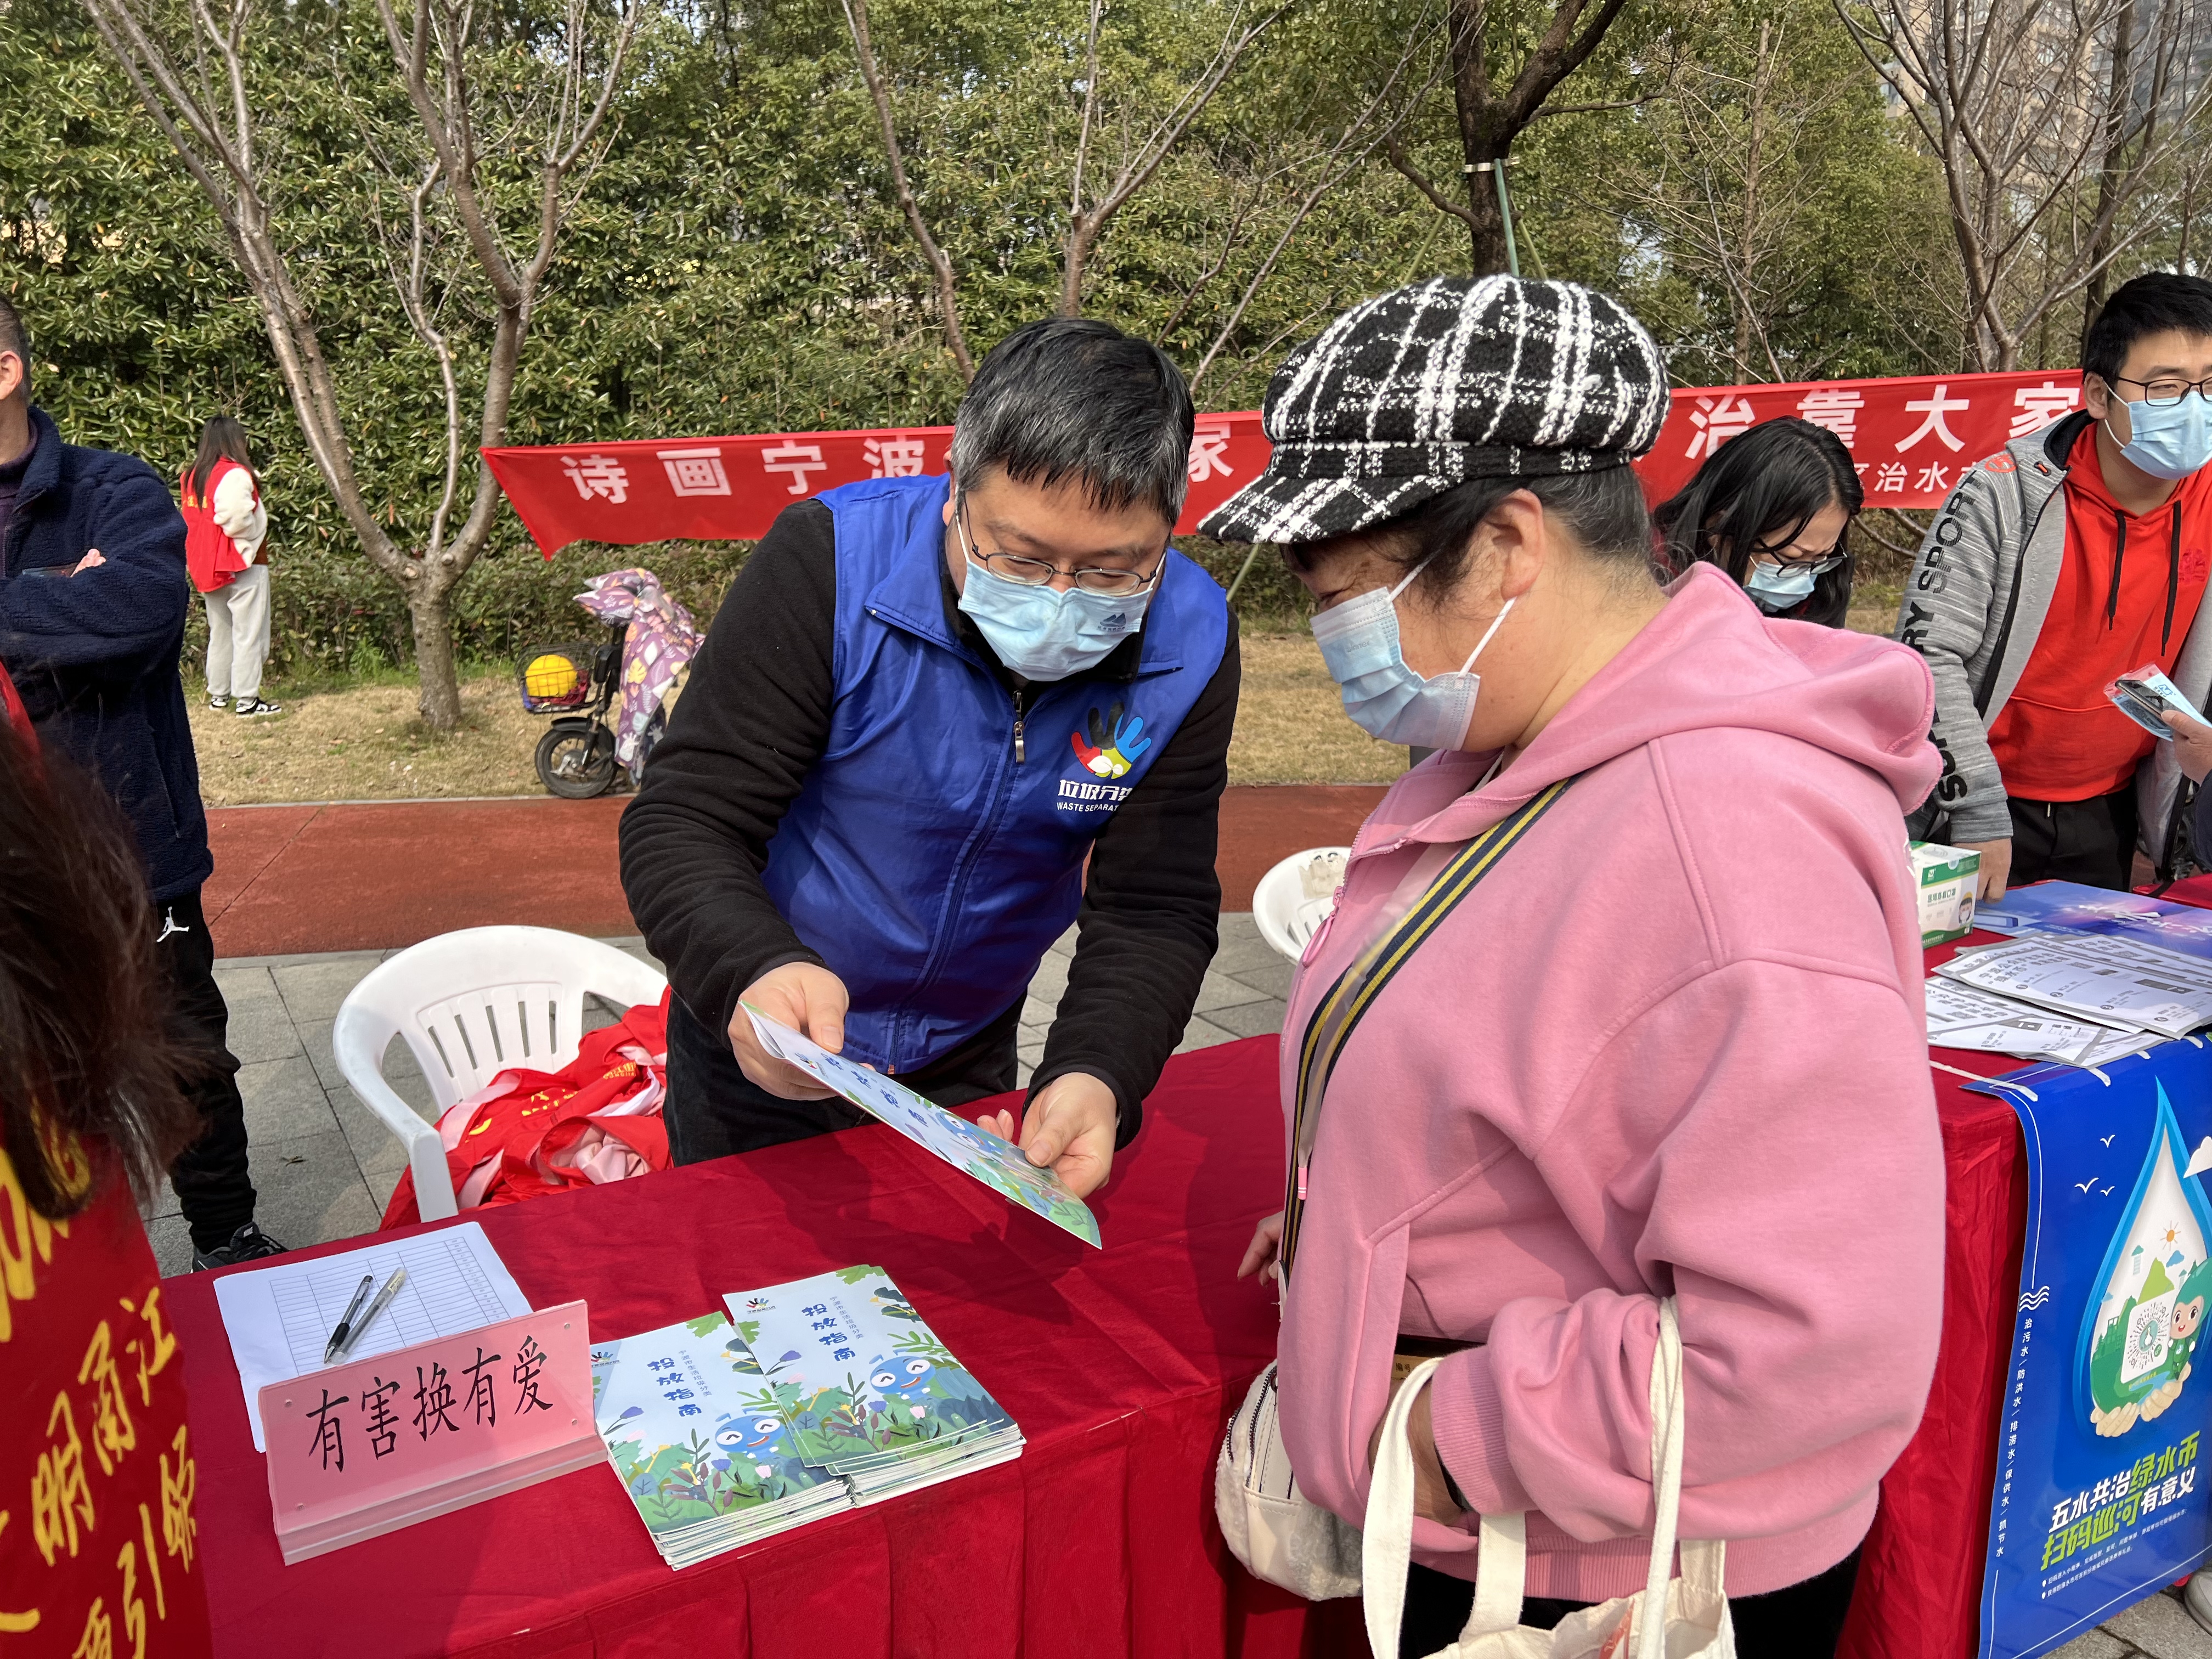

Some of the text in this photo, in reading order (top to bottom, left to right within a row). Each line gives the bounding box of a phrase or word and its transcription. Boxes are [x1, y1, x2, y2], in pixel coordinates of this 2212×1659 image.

[560, 435, 926, 504] 诗画宁波
[1917, 470, 1985, 594] SPORT
[1057, 802, 1084, 812] WASTE
[802, 1304, 856, 1361] 投放指南
[306, 1335, 554, 1472] 有害换有爱
[647, 1357, 702, 1417] 投放指南
